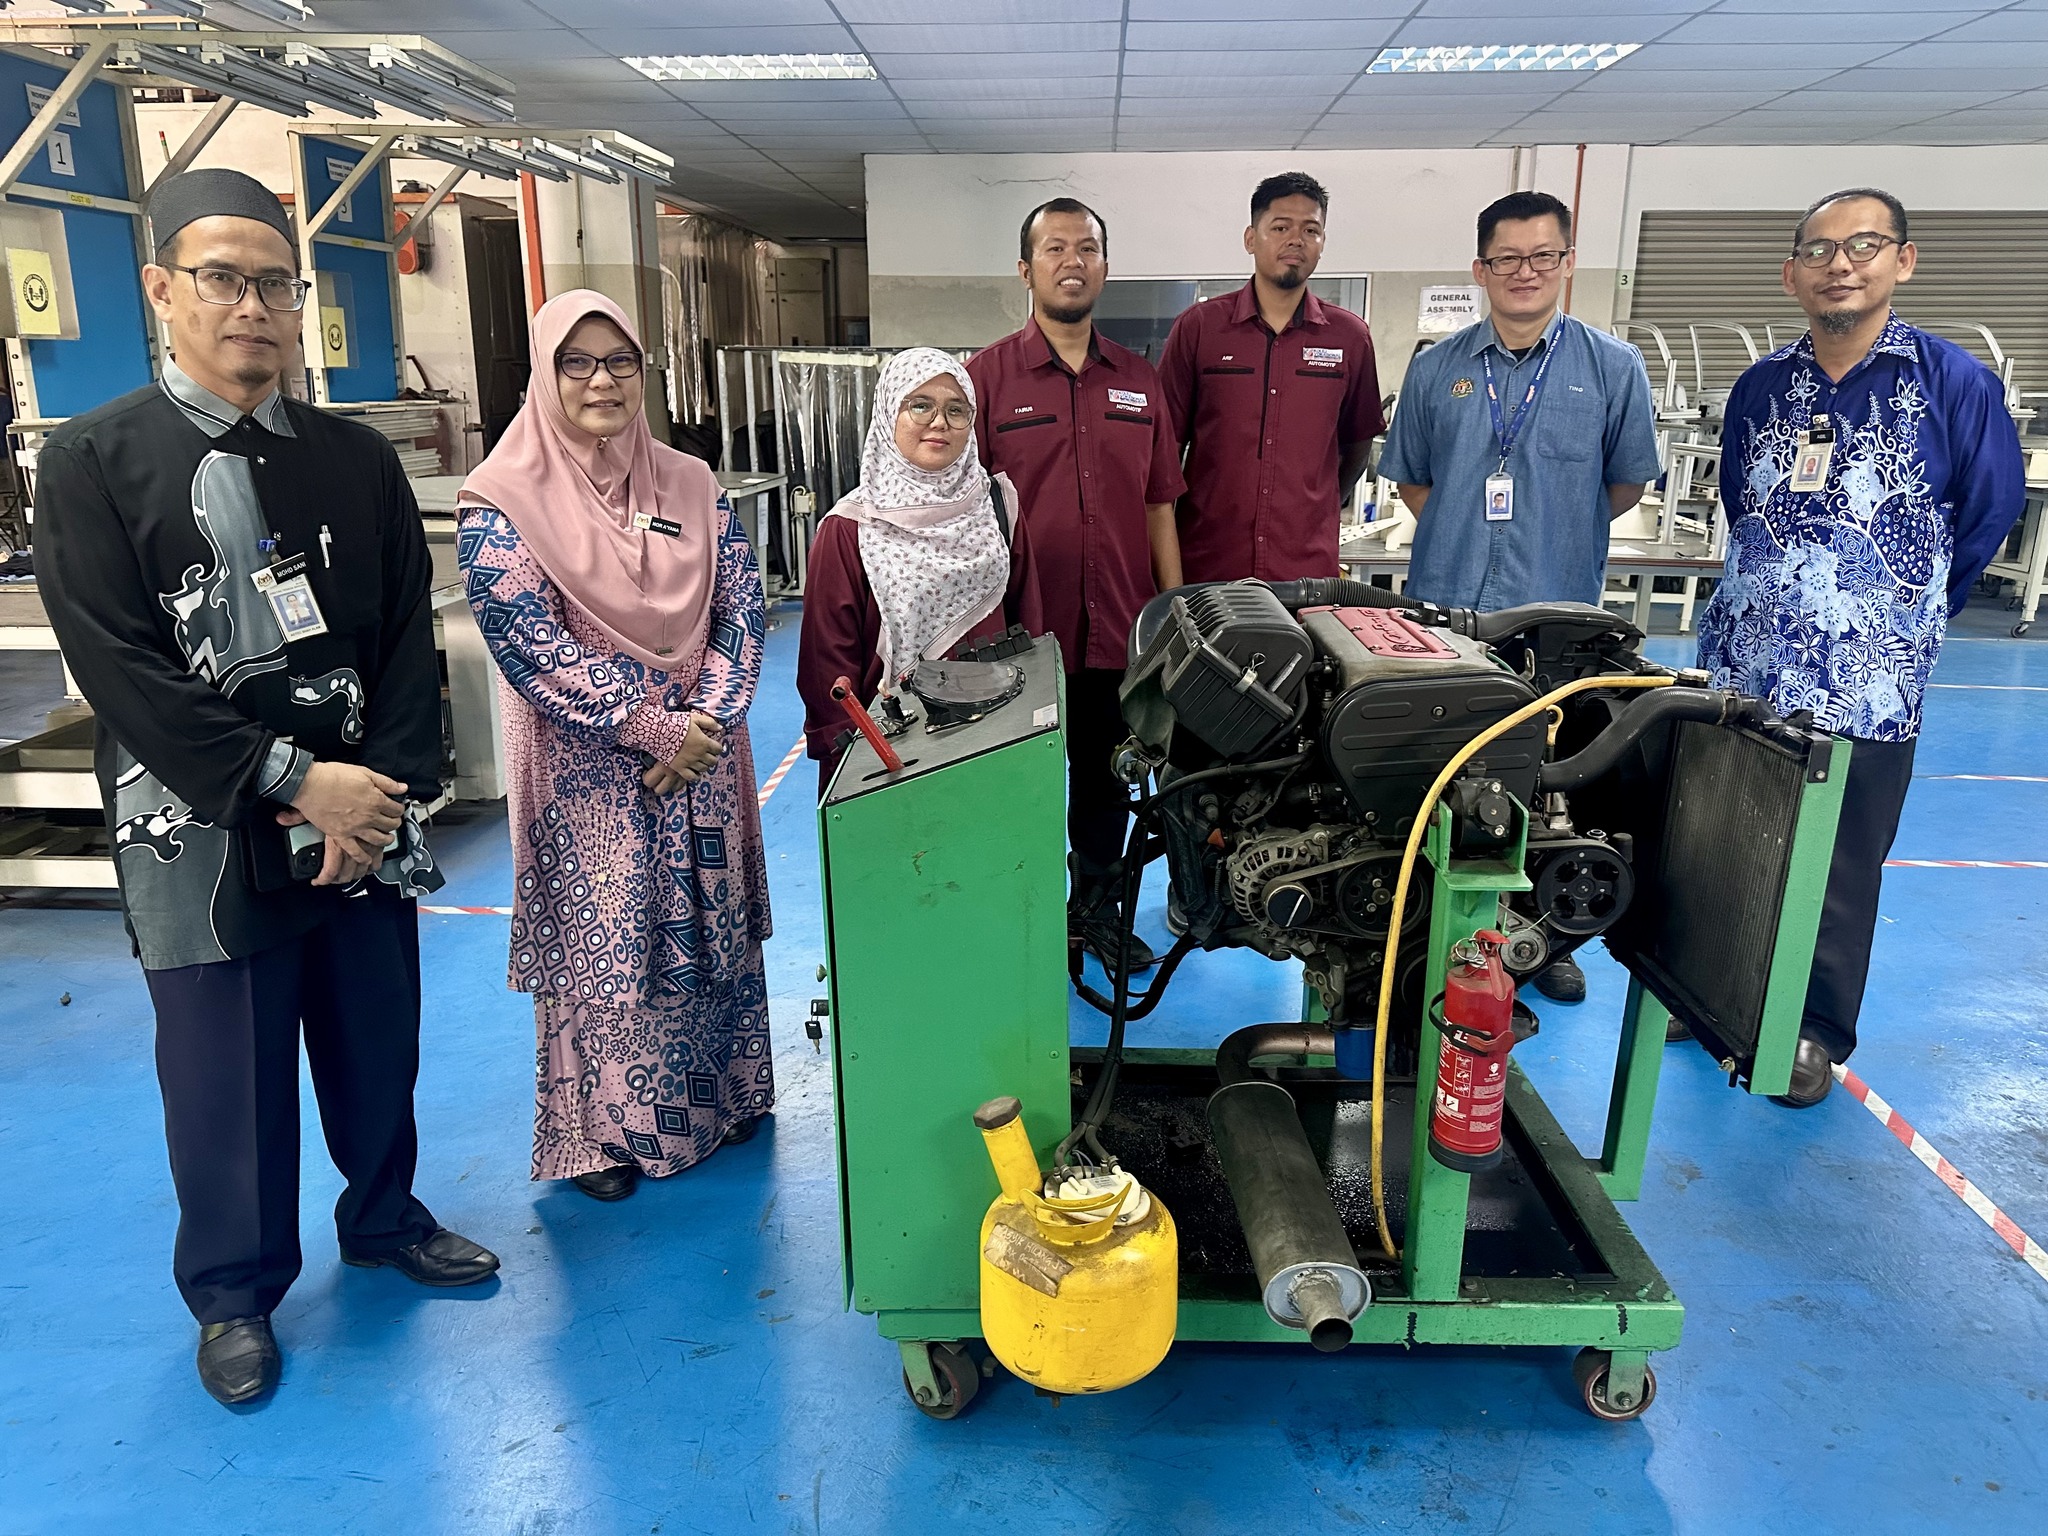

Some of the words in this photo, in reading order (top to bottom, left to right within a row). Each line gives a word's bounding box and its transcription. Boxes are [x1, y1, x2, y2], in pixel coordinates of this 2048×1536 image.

[55, 142, 66, 165] 1
[1621, 274, 1628, 285] 3
[1308, 360, 1336, 368] AUTOMOTIF
[1014, 406, 1033, 414] FAIRUS
[277, 566, 294, 578] MOHD
[293, 561, 307, 571] SANI
